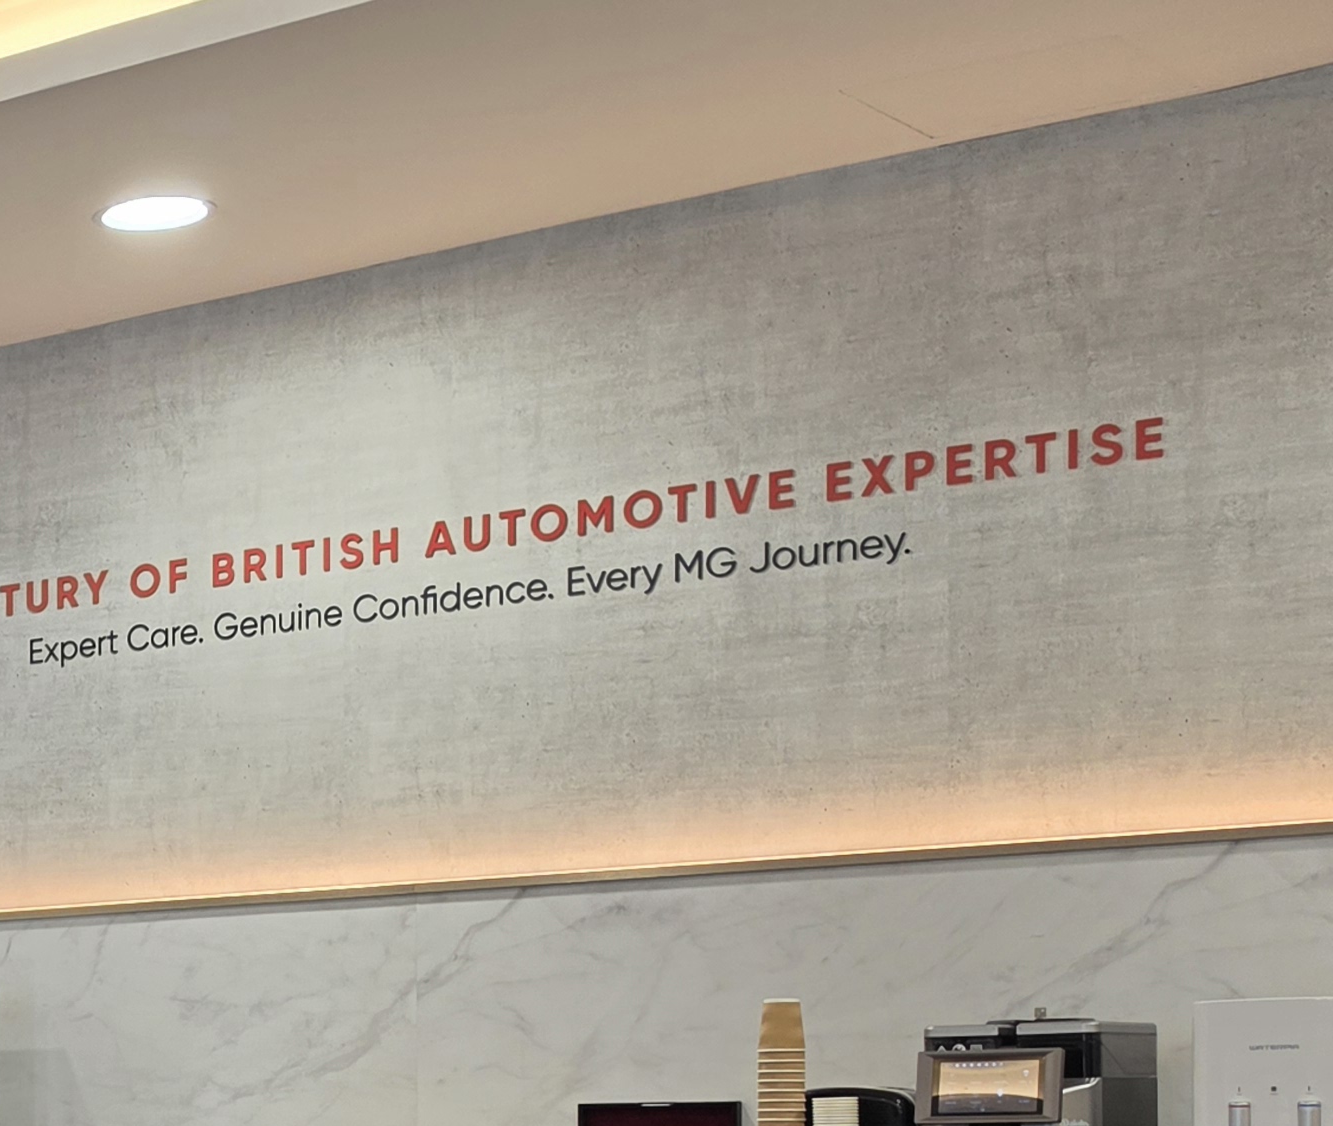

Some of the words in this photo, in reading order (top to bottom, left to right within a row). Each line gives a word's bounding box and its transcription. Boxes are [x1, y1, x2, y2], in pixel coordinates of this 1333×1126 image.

[130, 558, 188, 599] OF
[212, 527, 399, 588] BRITISH
[425, 469, 795, 559] AUTOMOTIVE
[826, 417, 1164, 502] EXPERTISE
[29, 630, 118, 668] Expert
[127, 624, 204, 651] Care.
[214, 603, 342, 640] Genuine
[353, 582, 554, 623] Confidence.
[567, 563, 663, 595] Every
[674, 547, 737, 583] MG
[749, 532, 911, 574] Journey.
